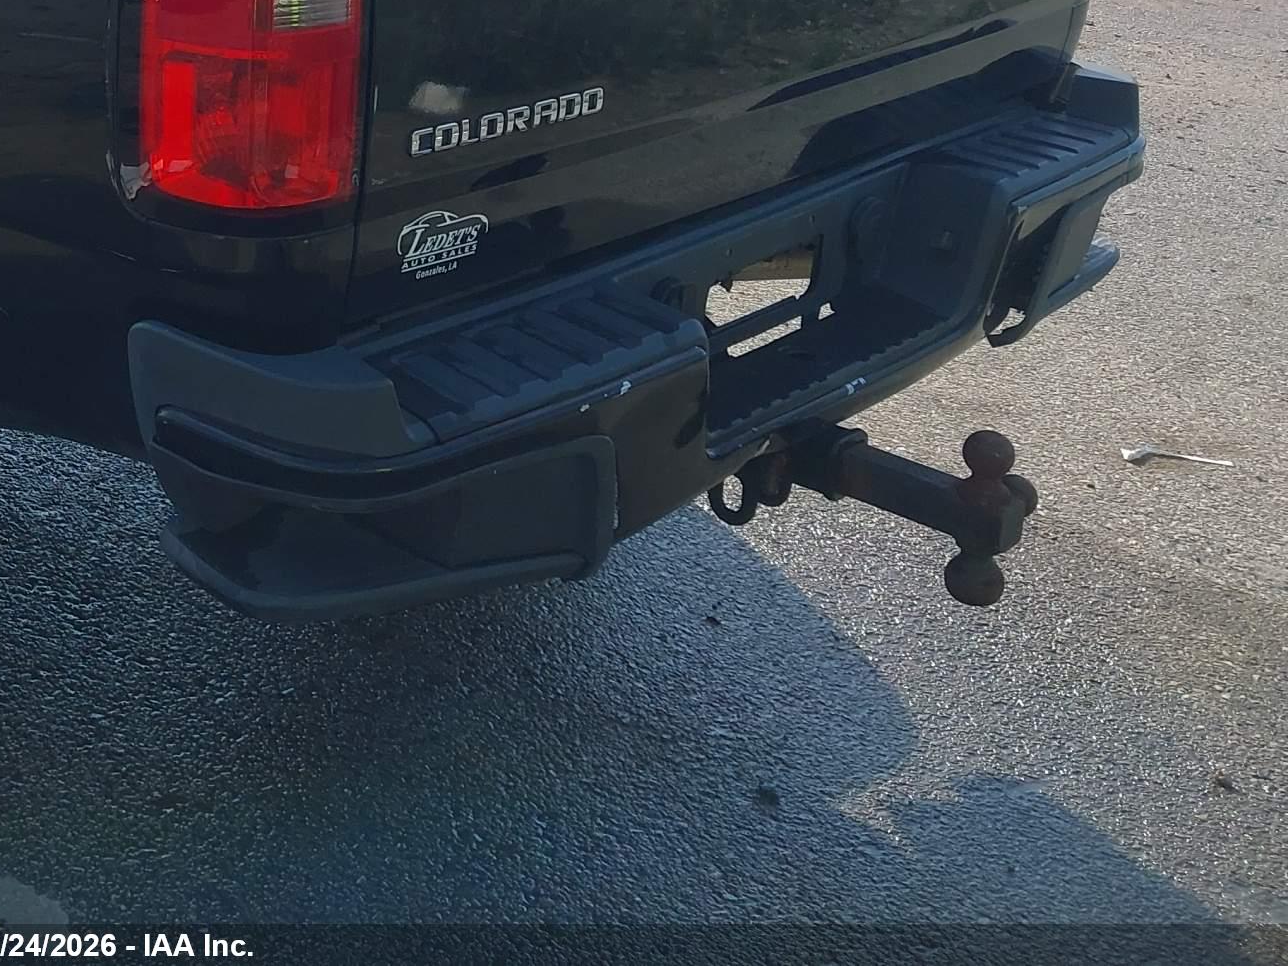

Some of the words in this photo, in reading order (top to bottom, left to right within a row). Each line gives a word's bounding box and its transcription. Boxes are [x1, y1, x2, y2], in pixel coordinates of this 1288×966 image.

[410, 86, 604, 157] COLORADO
[401, 255, 436, 270] AUTO
[441, 243, 478, 259] SALES
[415, 265, 448, 280] Gonzales,
[448, 260, 458, 272] LA
